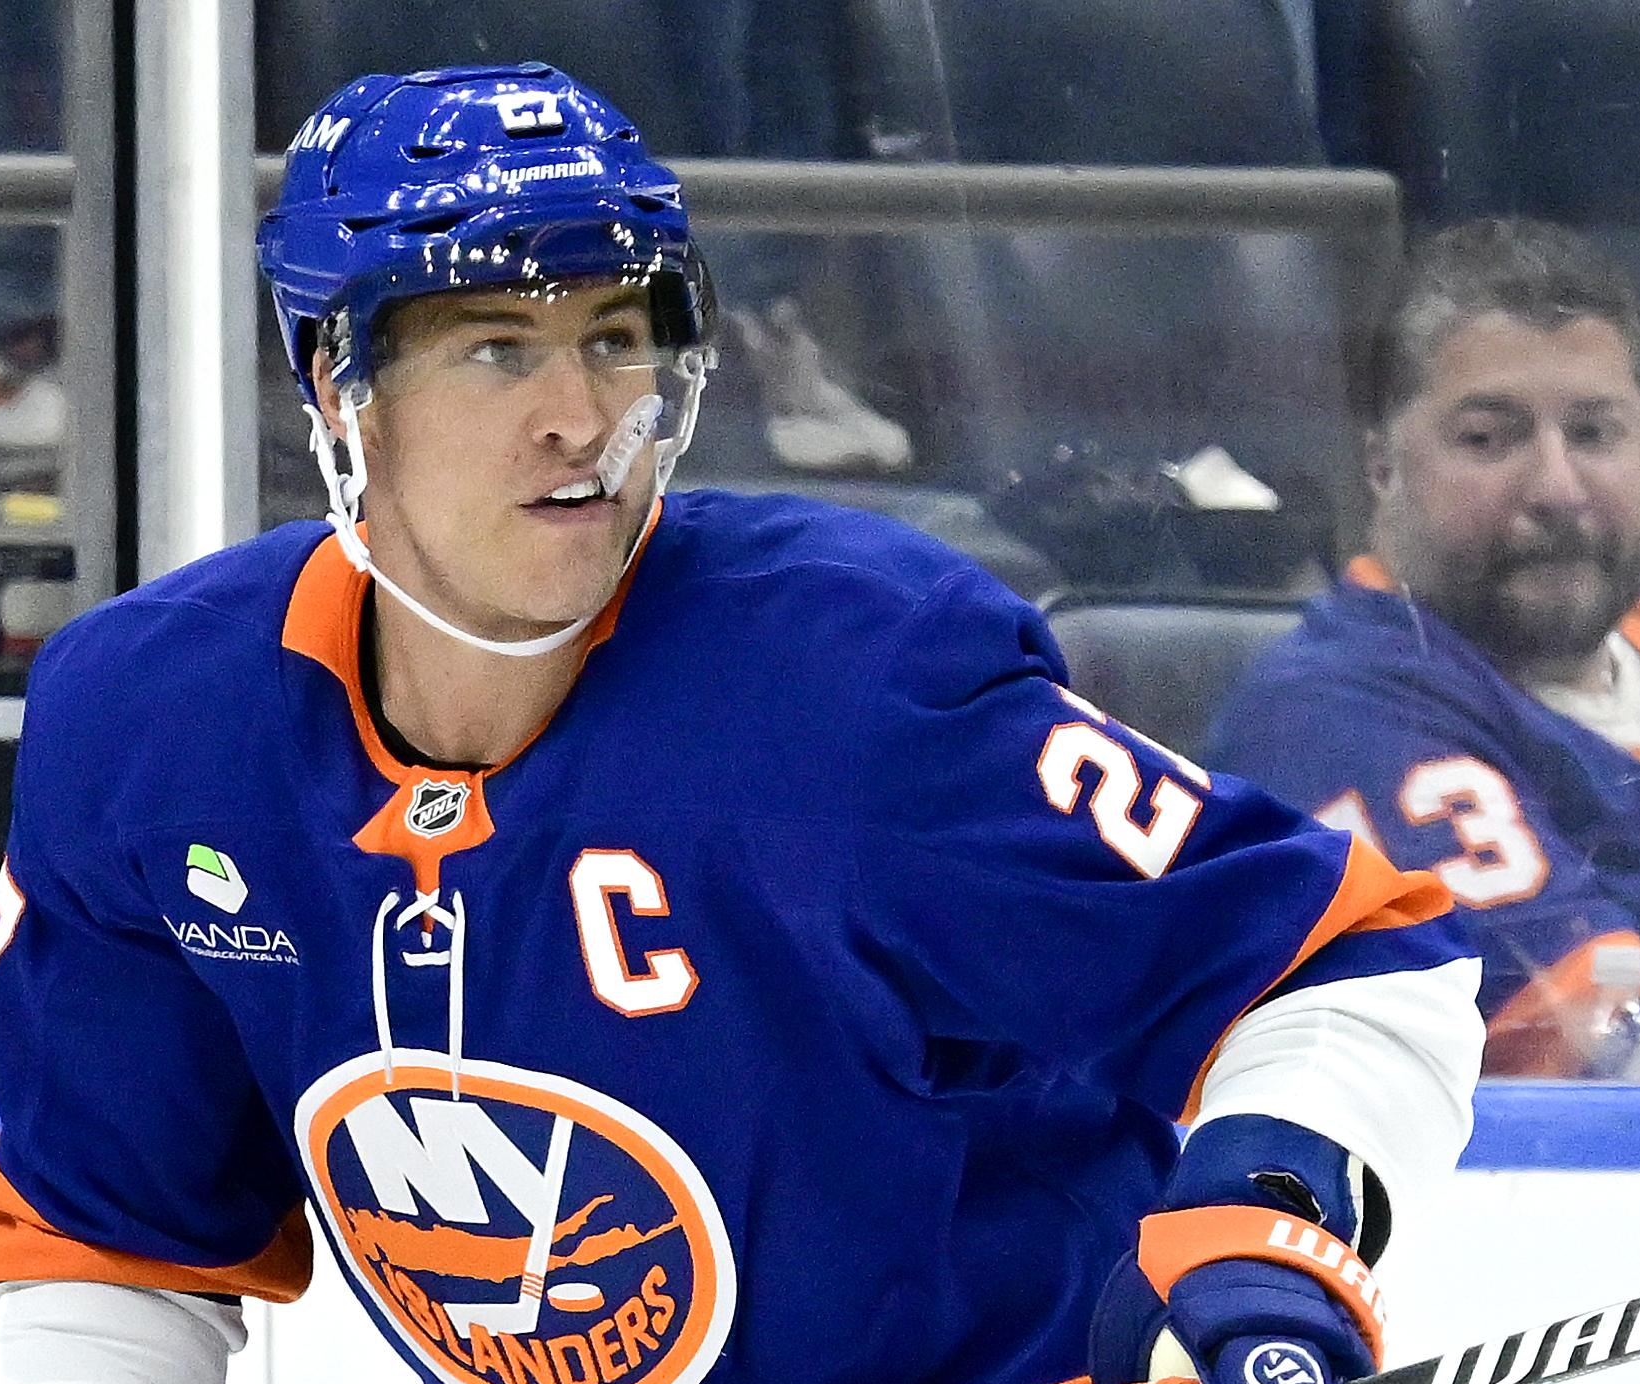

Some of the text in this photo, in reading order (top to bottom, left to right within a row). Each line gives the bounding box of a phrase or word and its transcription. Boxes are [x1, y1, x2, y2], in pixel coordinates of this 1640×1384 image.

[418, 796, 458, 825] NHL
[163, 914, 297, 956] VANDA
[569, 848, 701, 1018] C
[344, 1095, 573, 1290] NY
